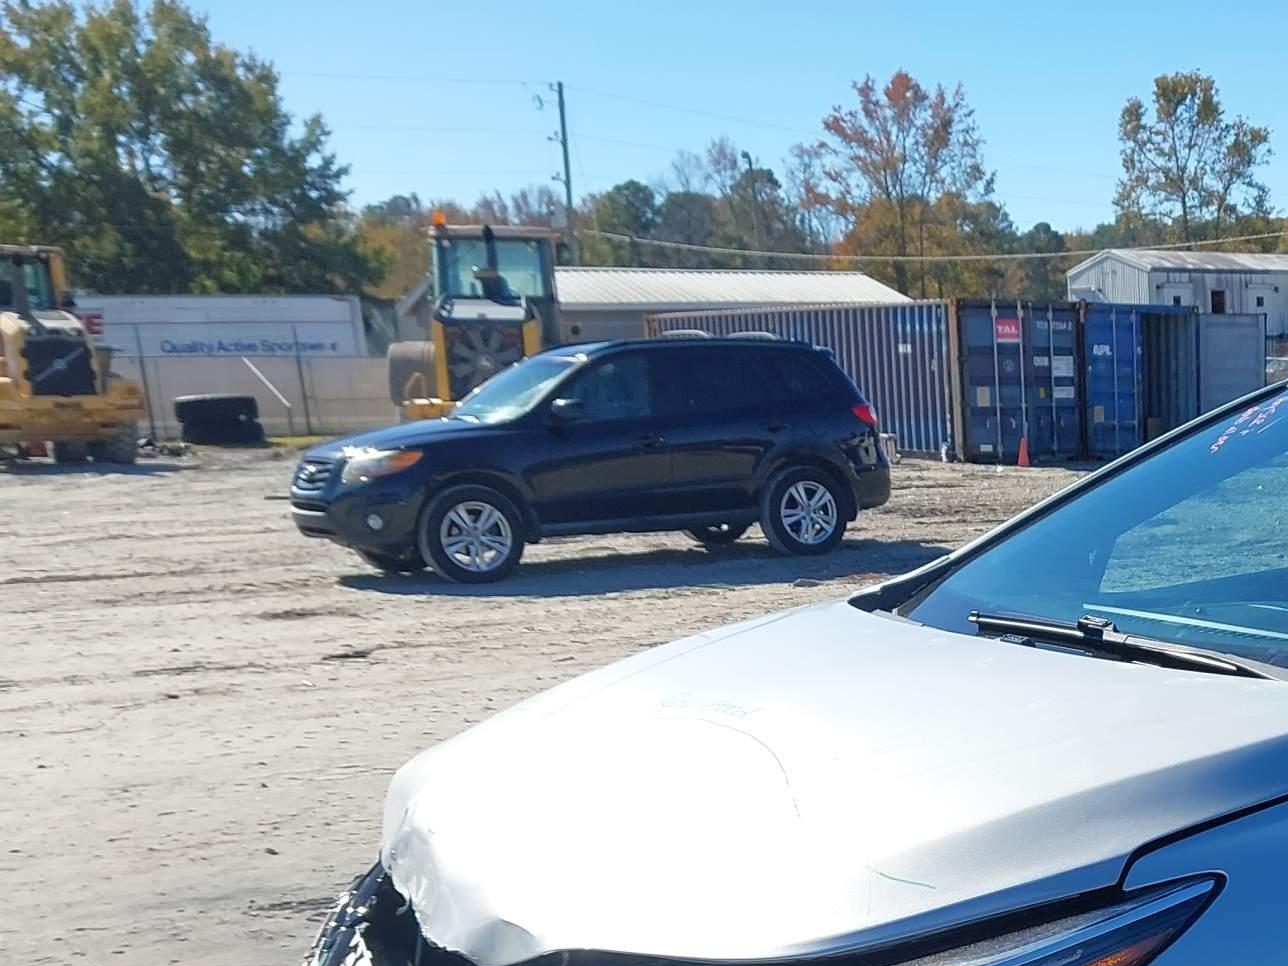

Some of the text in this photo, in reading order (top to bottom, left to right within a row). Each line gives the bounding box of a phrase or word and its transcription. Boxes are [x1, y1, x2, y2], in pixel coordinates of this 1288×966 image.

[996, 324, 1019, 334] TAL
[160, 340, 337, 354] Quality Active Sportswer
[1093, 344, 1112, 356] APL
